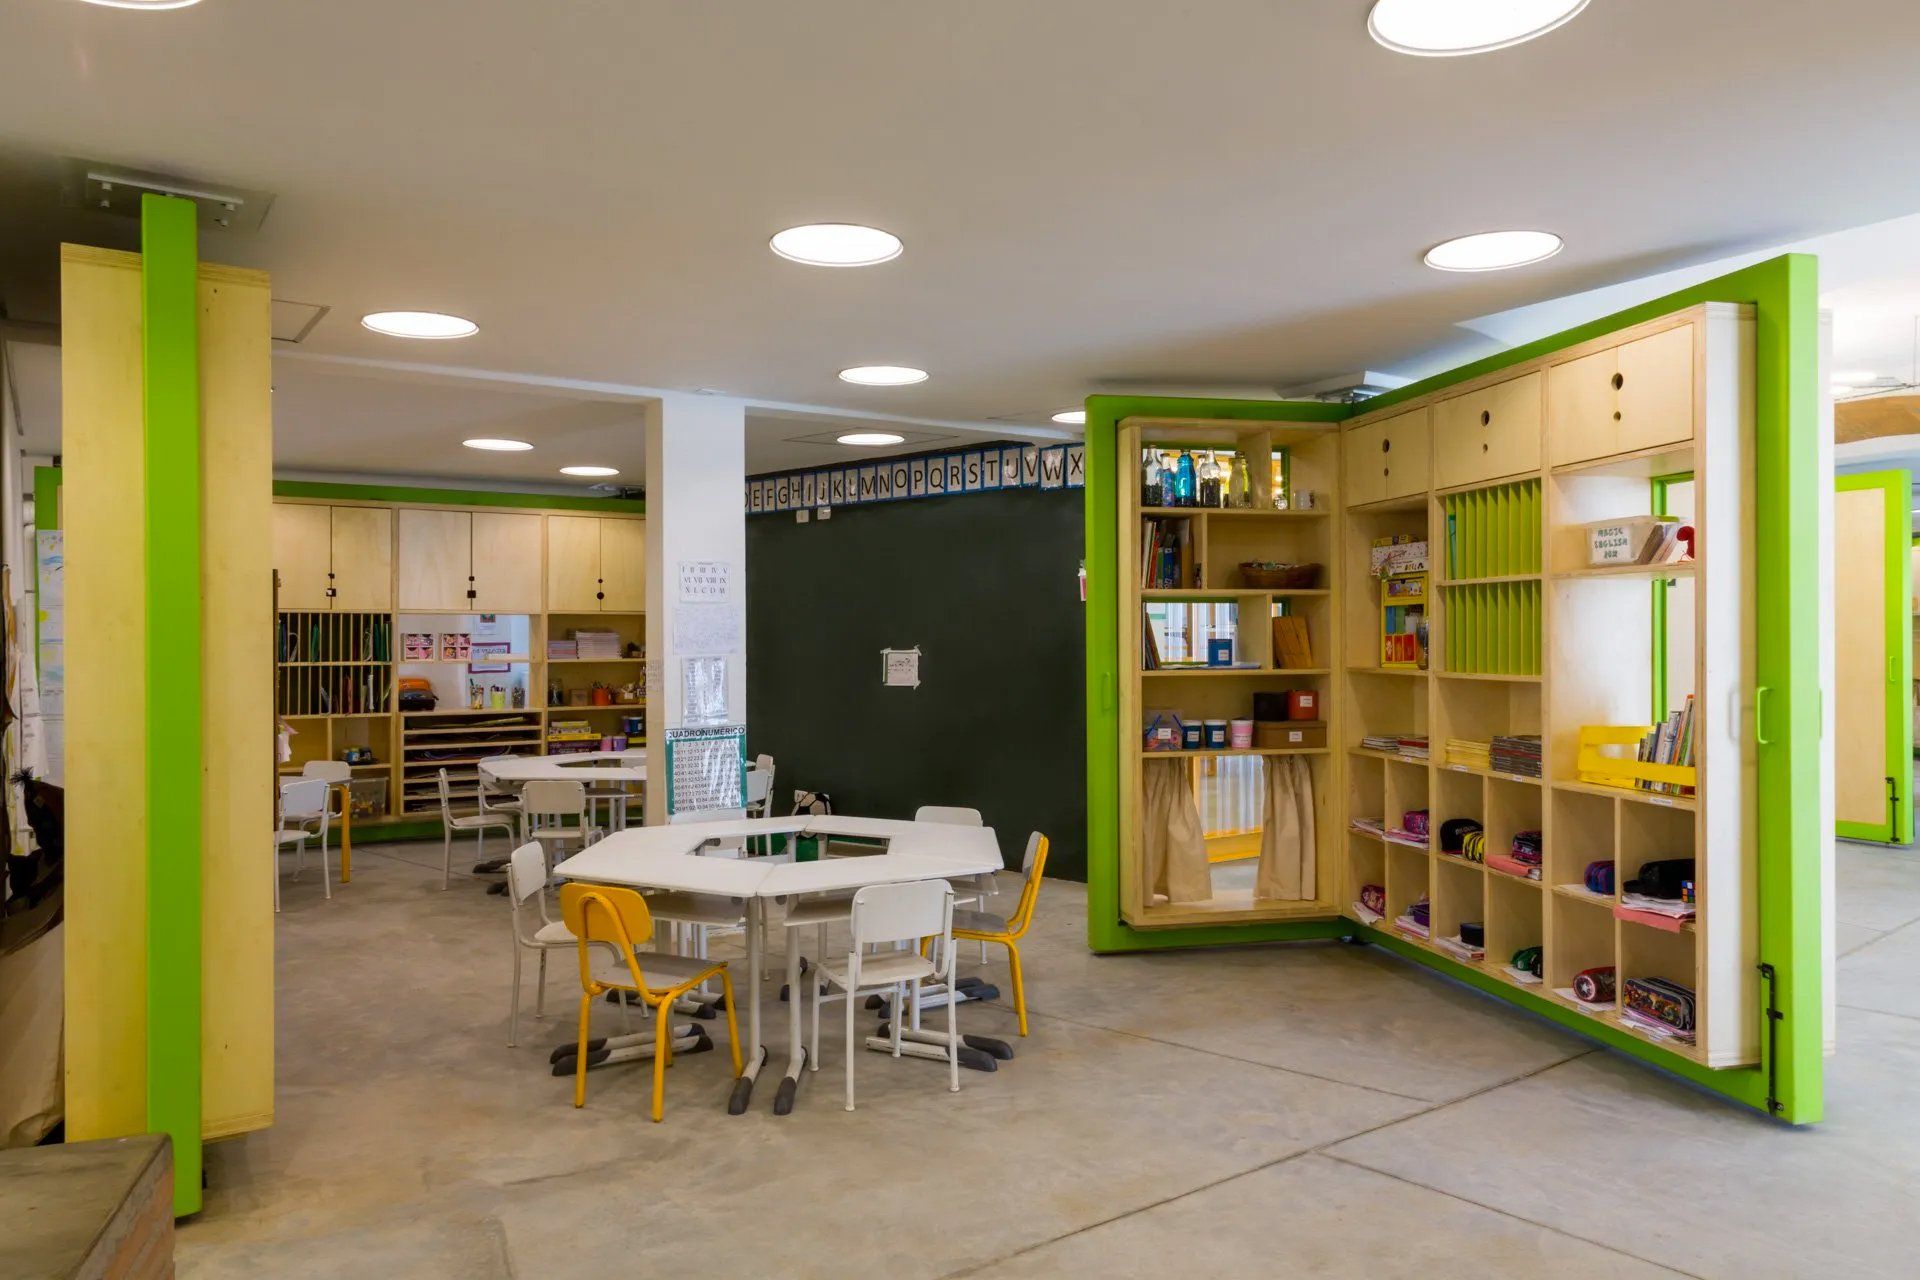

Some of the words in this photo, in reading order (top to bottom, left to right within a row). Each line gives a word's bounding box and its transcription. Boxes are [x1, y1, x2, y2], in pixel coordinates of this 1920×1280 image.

[753, 489, 759, 507] E
[767, 488, 773, 506] F
[778, 486, 787, 504] G
[792, 482, 800, 499] H
[834, 479, 842, 498] K
[861, 477, 876, 495] M
[879, 474, 889, 494] N
[894, 469, 907, 488] O
[914, 470, 923, 489] P
[930, 467, 944, 489] Q
[951, 466, 960, 485] R
[968, 463, 978, 484] S
[986, 460, 998, 481] T
[1006, 458, 1019, 479] U
[1024, 456, 1038, 477] V
[1043, 457, 1062, 481] W
[1070, 453, 1083, 475] X
[669, 729, 702, 738] UADRO
